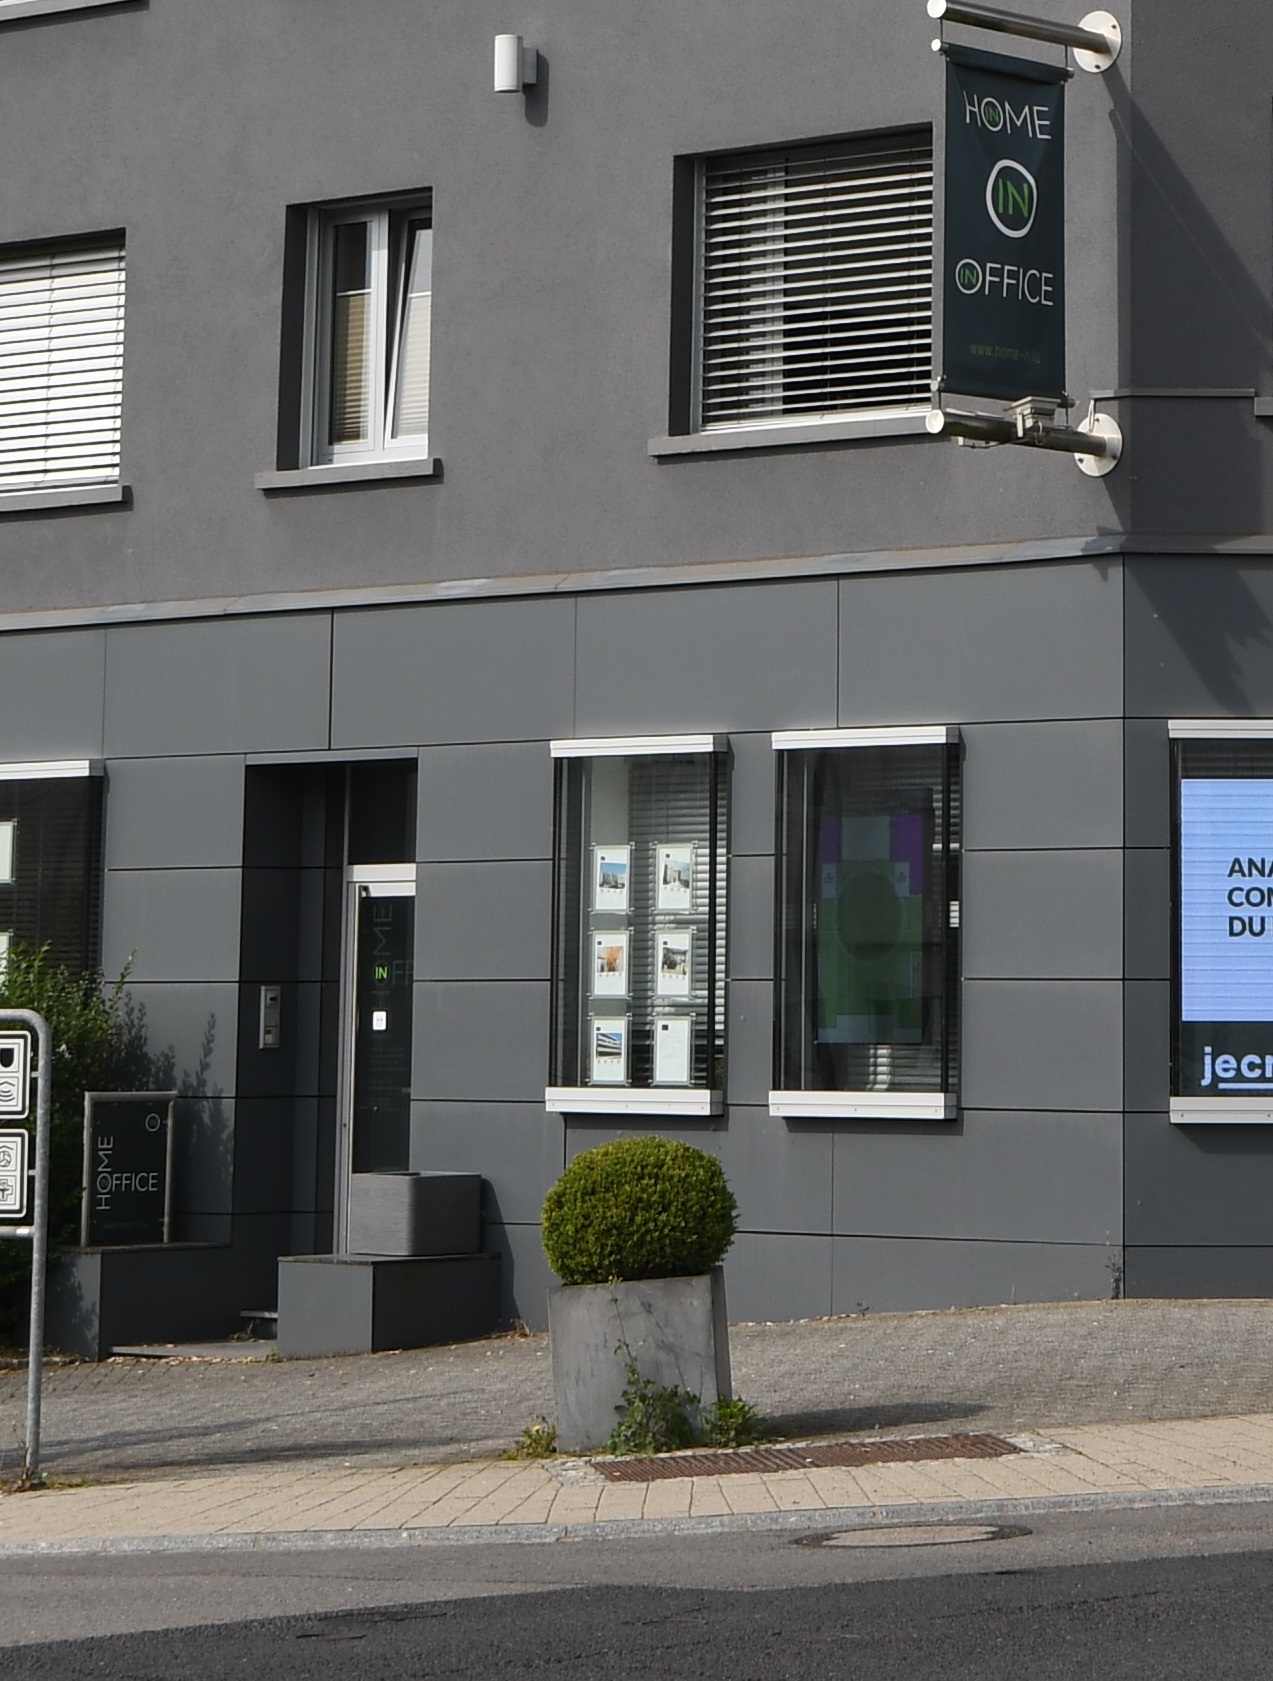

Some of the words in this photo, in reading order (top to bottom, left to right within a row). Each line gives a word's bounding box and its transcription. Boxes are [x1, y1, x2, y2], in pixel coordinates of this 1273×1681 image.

[962, 90, 1052, 140] HOME
[996, 178, 1030, 218] IN
[955, 258, 1054, 307] OFFICE
[1228, 916, 1267, 938] DU
[374, 966, 388, 980] IN
[96, 1136, 114, 1210] HOME
